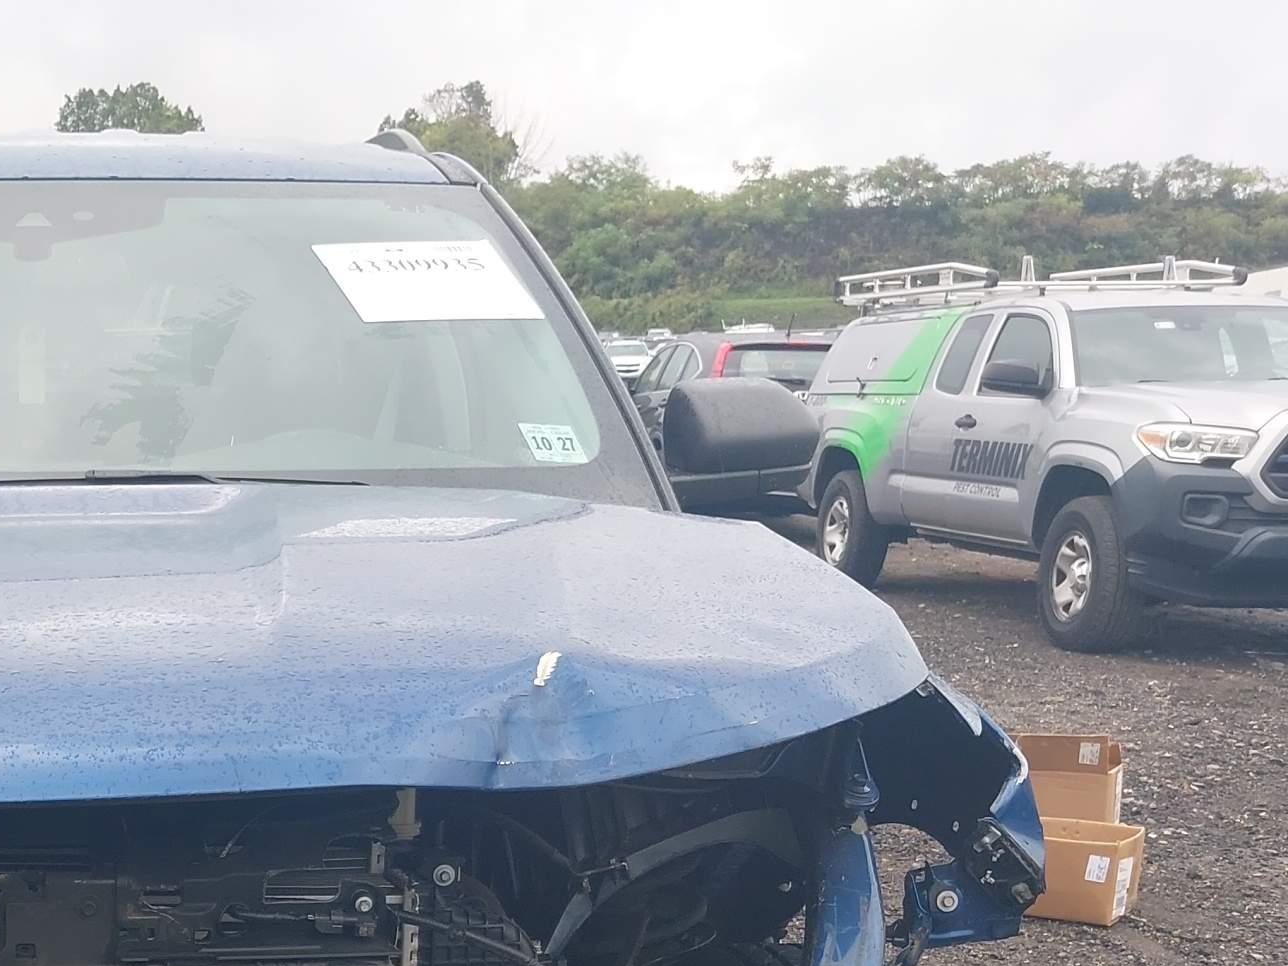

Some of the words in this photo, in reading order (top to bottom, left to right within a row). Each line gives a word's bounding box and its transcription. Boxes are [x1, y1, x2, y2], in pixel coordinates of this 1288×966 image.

[531, 435, 553, 451] 10
[556, 436, 576, 452] 27
[949, 438, 1034, 480] TERMINIX
[952, 481, 972, 494] PEST
